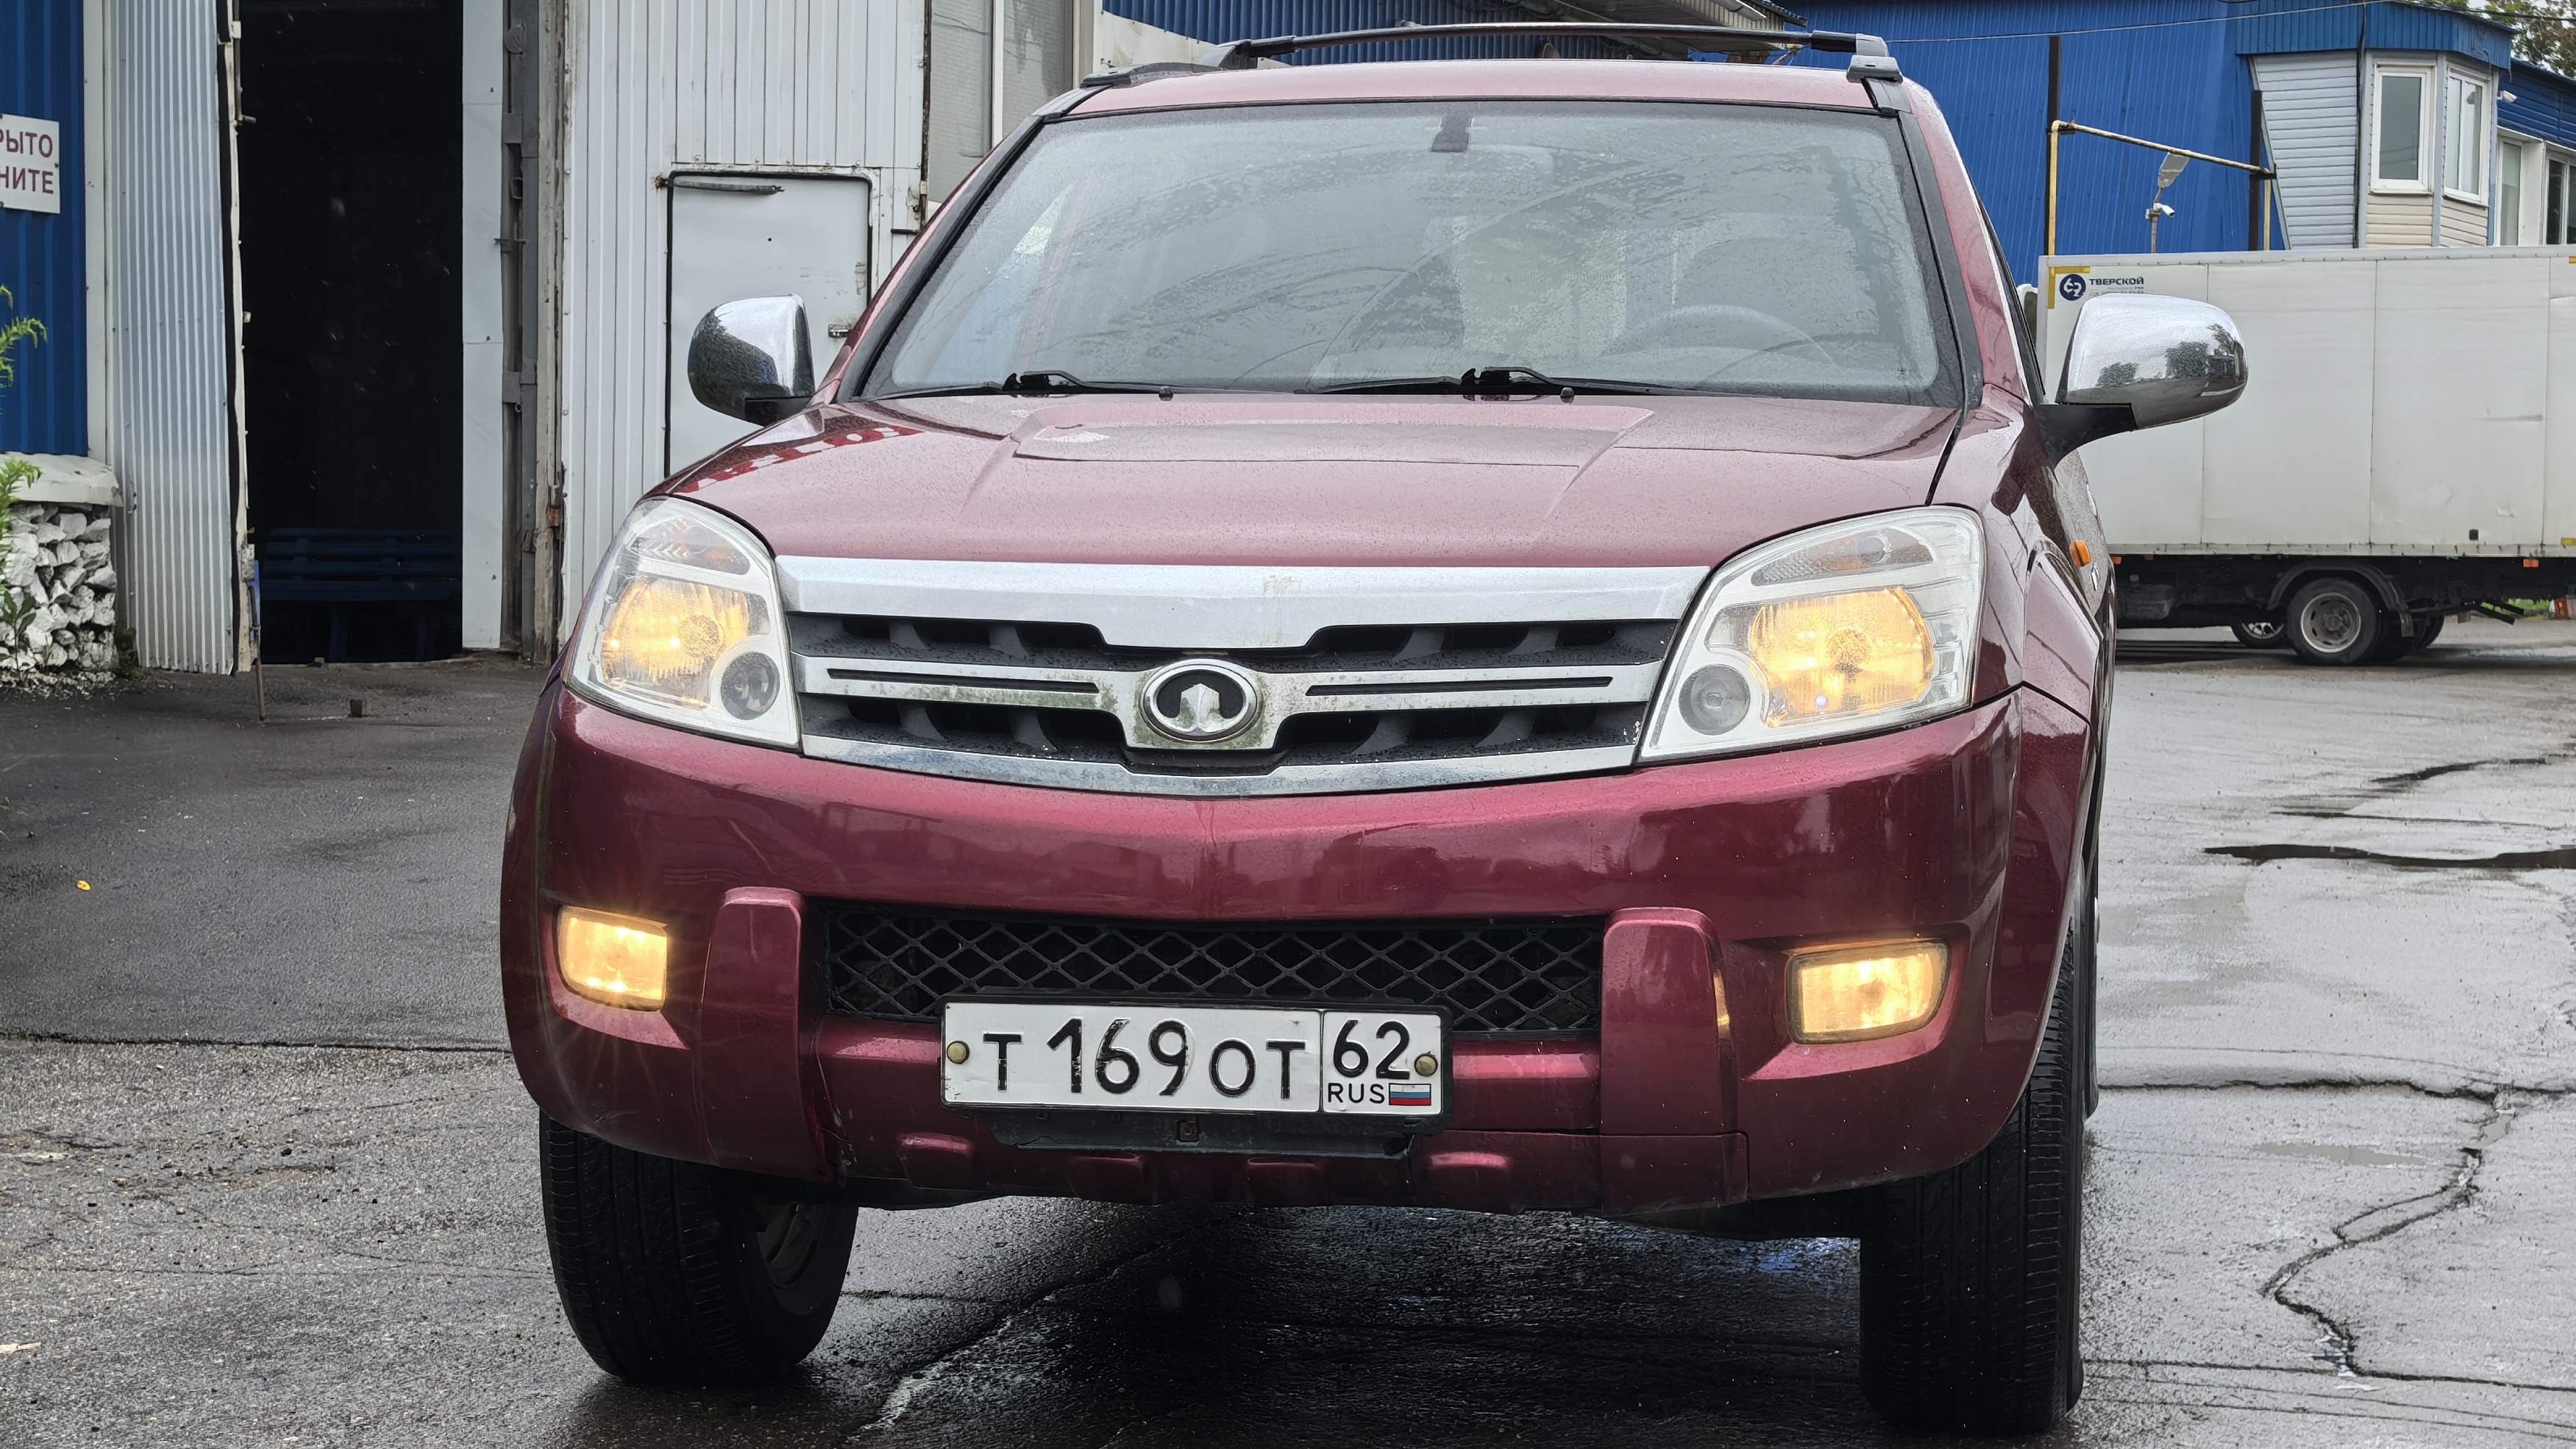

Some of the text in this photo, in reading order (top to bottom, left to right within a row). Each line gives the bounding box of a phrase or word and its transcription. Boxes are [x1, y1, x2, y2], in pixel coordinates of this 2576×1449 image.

[2089, 277, 2144, 285] ТВЕРСКОЙ
[1333, 1019, 1410, 1079] 62
[1328, 1083, 1385, 1103] RUS
